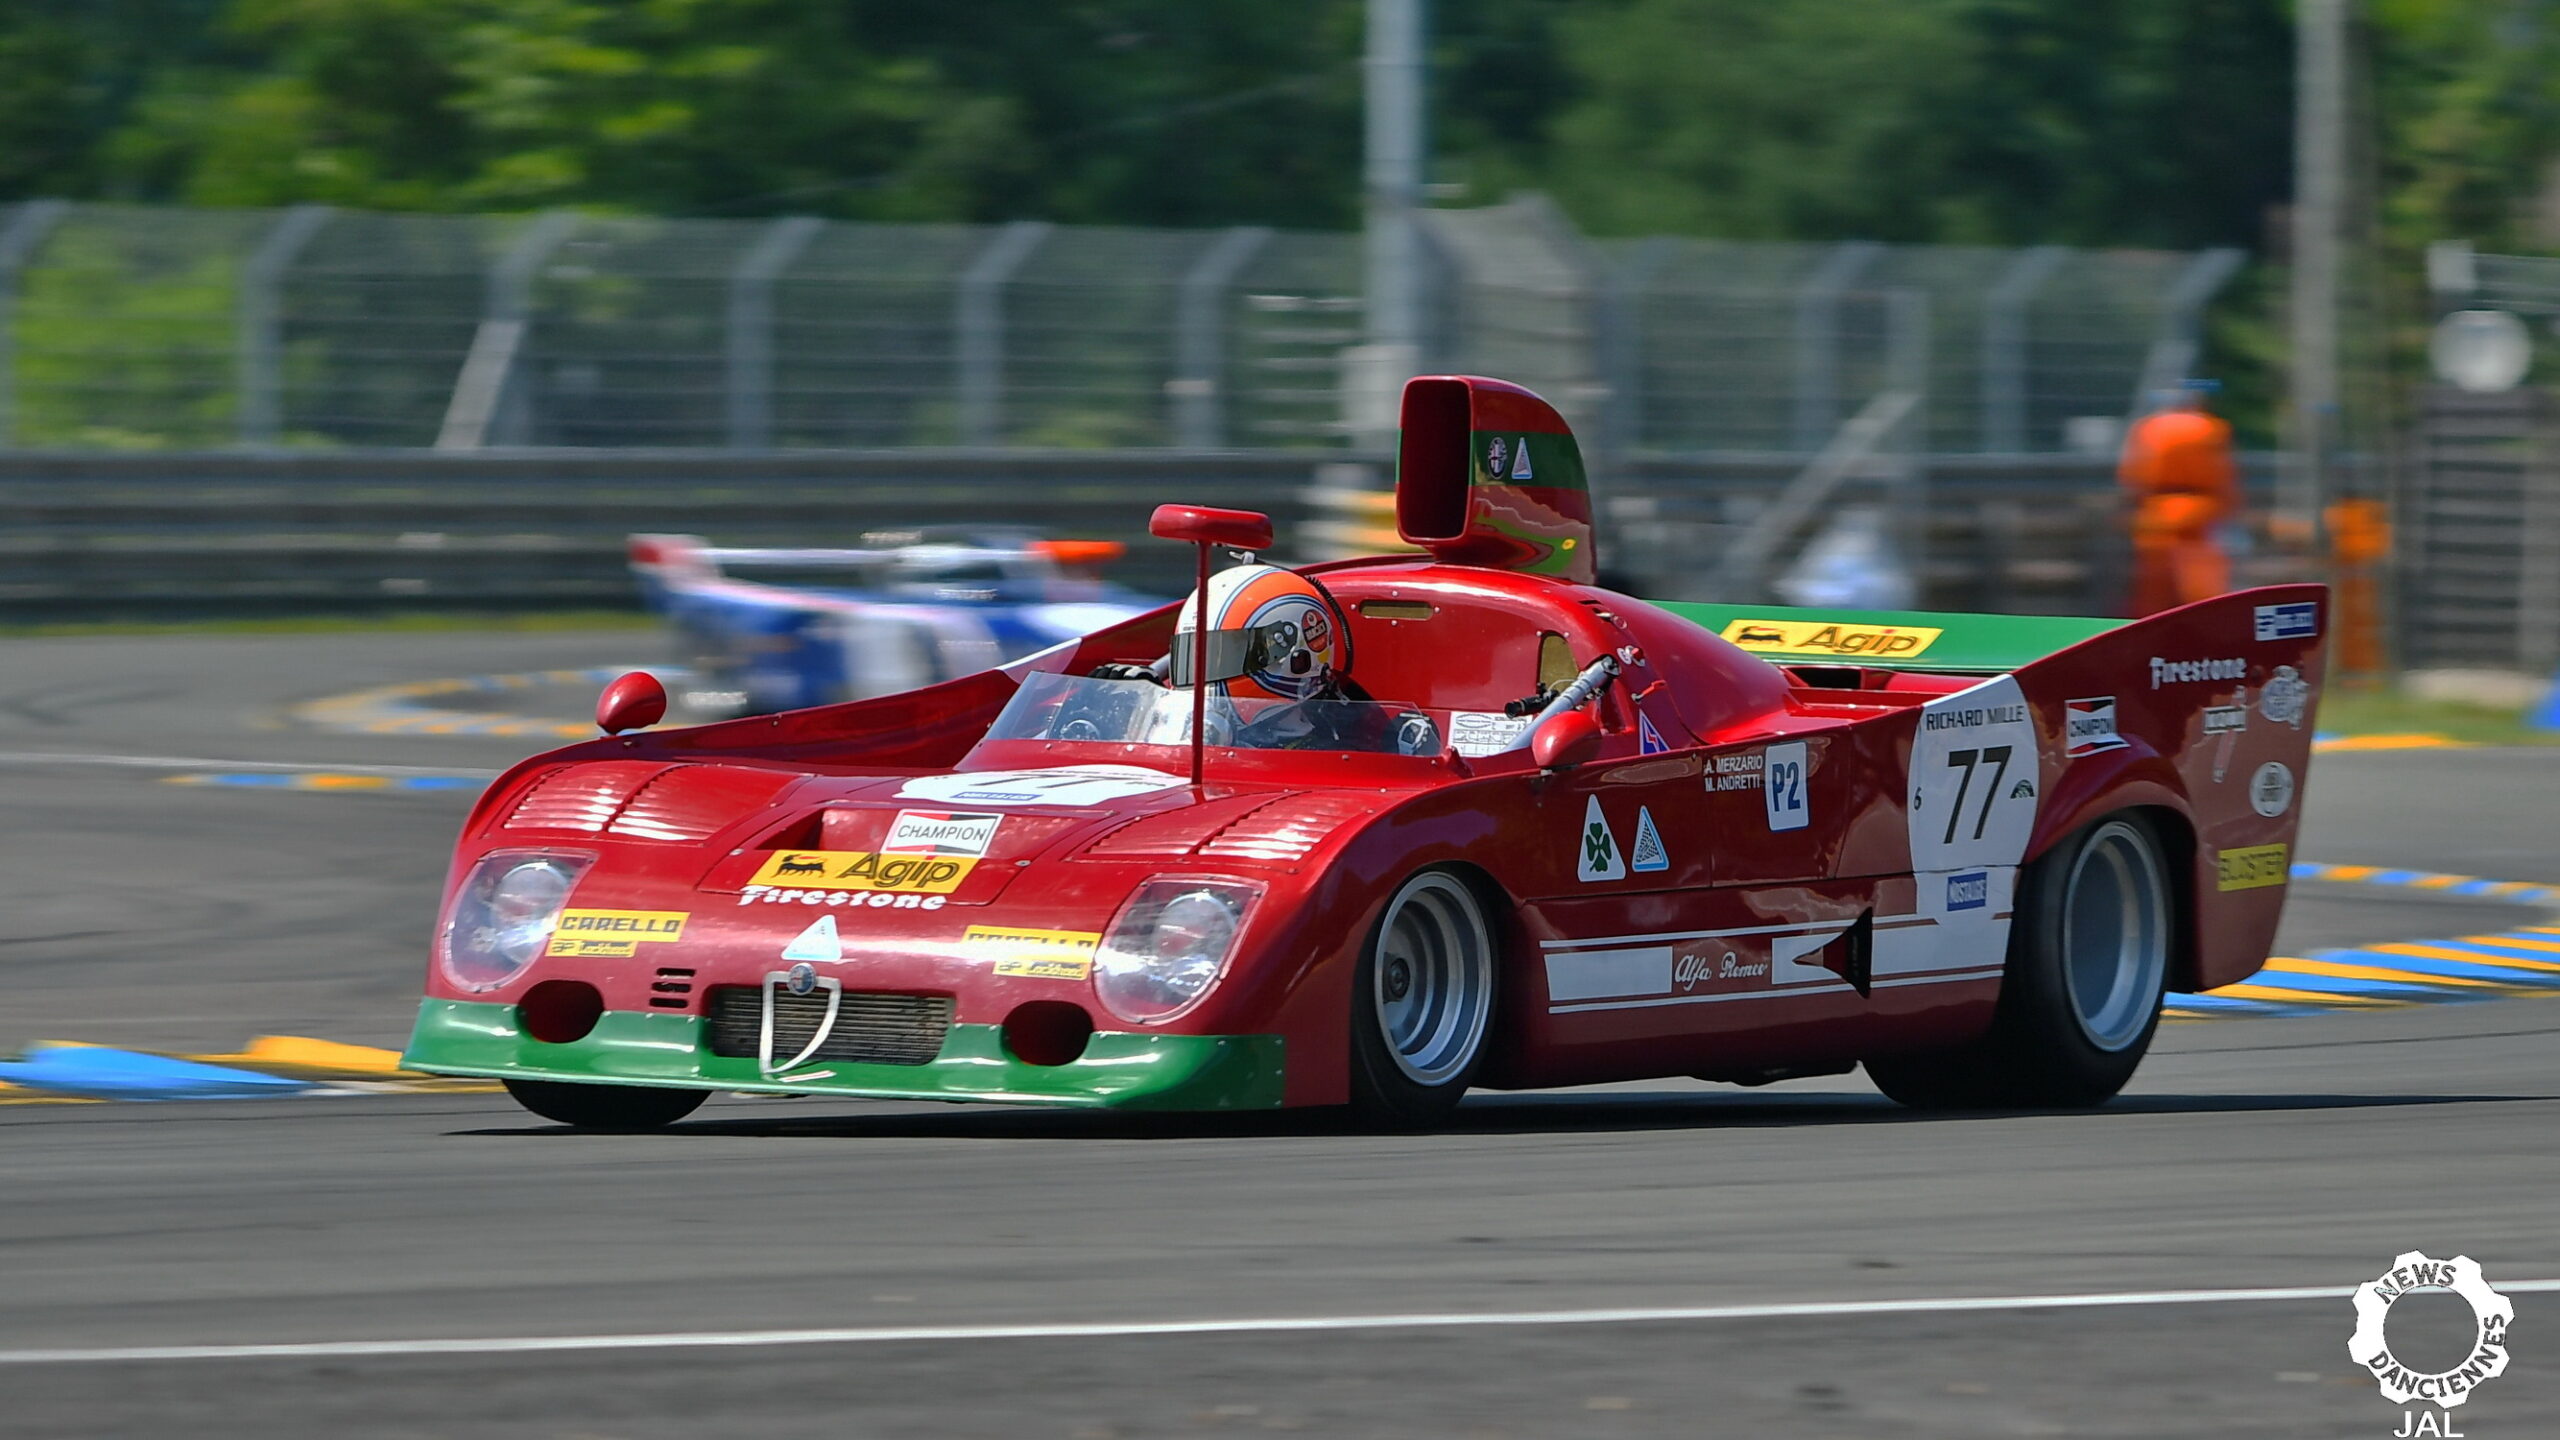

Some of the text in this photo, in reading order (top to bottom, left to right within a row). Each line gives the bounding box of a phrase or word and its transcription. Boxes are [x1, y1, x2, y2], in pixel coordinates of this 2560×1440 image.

[1795, 627, 1919, 654] Agip
[2150, 657, 2247, 690] Firestone
[1926, 705, 2025, 731] RICHARD MILLE
[1704, 755, 1763, 774] A. MERZARIO
[1717, 774, 1760, 791] ANDRETTI
[1772, 761, 1801, 812] P2
[1944, 745, 2012, 844] 77
[1913, 786, 1922, 811] 6
[897, 824, 988, 842] CHAMPION
[835, 852, 960, 888] Agip
[737, 885, 948, 910] Firestone
[560, 916, 681, 933] CARELLO
[1675, 951, 1768, 992] Alfa Romeo
